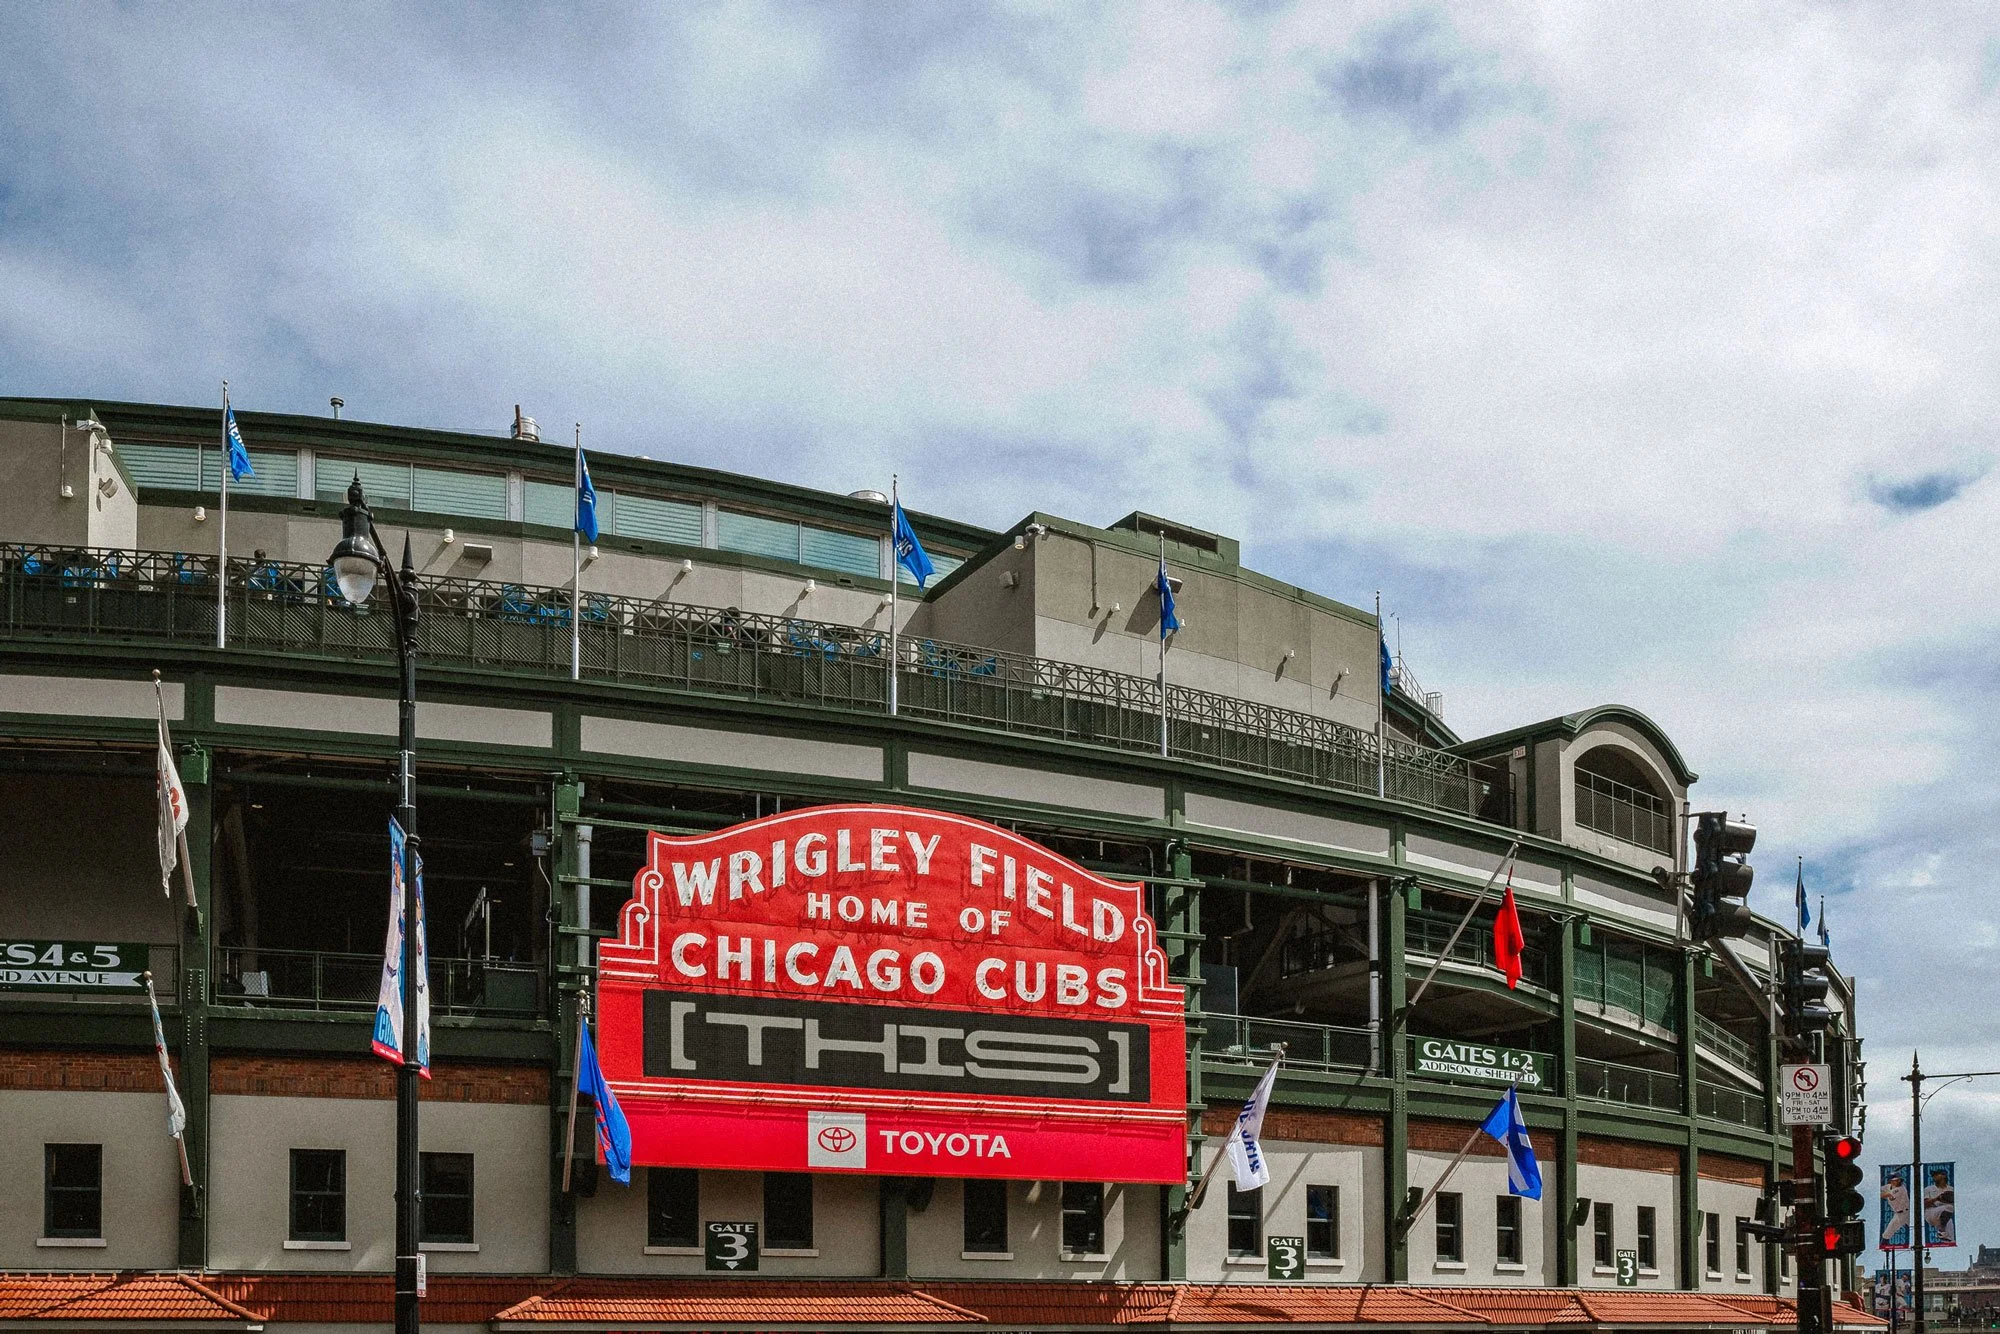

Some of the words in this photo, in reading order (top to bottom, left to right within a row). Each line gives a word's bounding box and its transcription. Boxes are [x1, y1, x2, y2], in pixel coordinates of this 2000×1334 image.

[671, 828, 941, 907] WRIGLEY
[970, 842, 1125, 944] FIELD
[808, 892, 928, 929] HOME
[959, 906, 1012, 935] OF
[28, 971, 110, 984] AVENUE
[671, 932, 945, 995] CHICAGO
[975, 957, 1128, 1009] CUBS
[1423, 1041, 1497, 1065] GATES
[1423, 1061, 1471, 1074] ADDISON
[1474, 1068, 1482, 1076] &
[880, 1128, 1012, 1159] TOYOTA
[709, 1223, 755, 1233] GATE
[715, 1233, 749, 1260] 3
[1270, 1237, 1302, 1247] GATE
[1617, 1250, 1636, 1258] GATE
[1275, 1246, 1298, 1270] 3
[1620, 1258, 1634, 1278] 3
